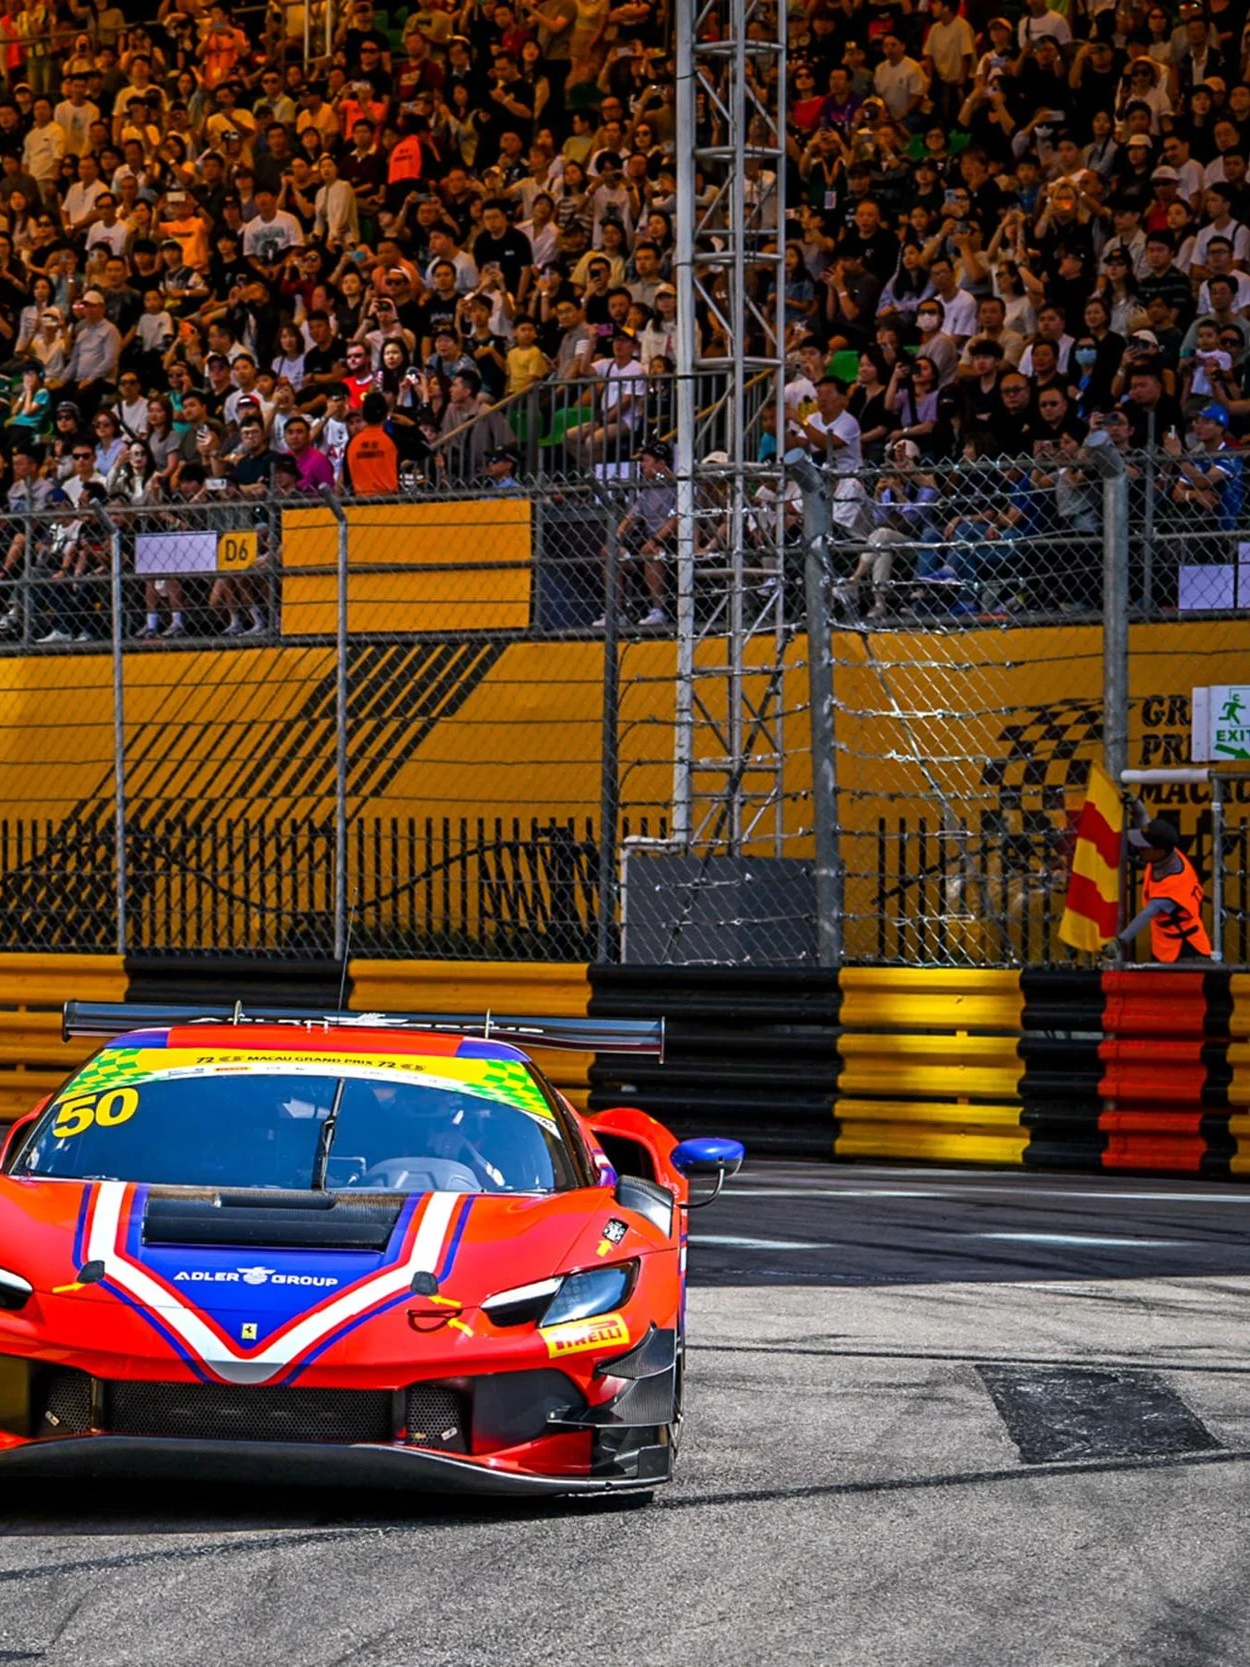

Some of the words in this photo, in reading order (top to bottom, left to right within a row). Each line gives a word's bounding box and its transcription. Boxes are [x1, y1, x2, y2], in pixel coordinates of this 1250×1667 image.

[225, 538, 249, 562] D6
[52, 1087, 139, 1138] 50
[173, 1271, 240, 1281] ADLER
[271, 1274, 339, 1287] GROUP
